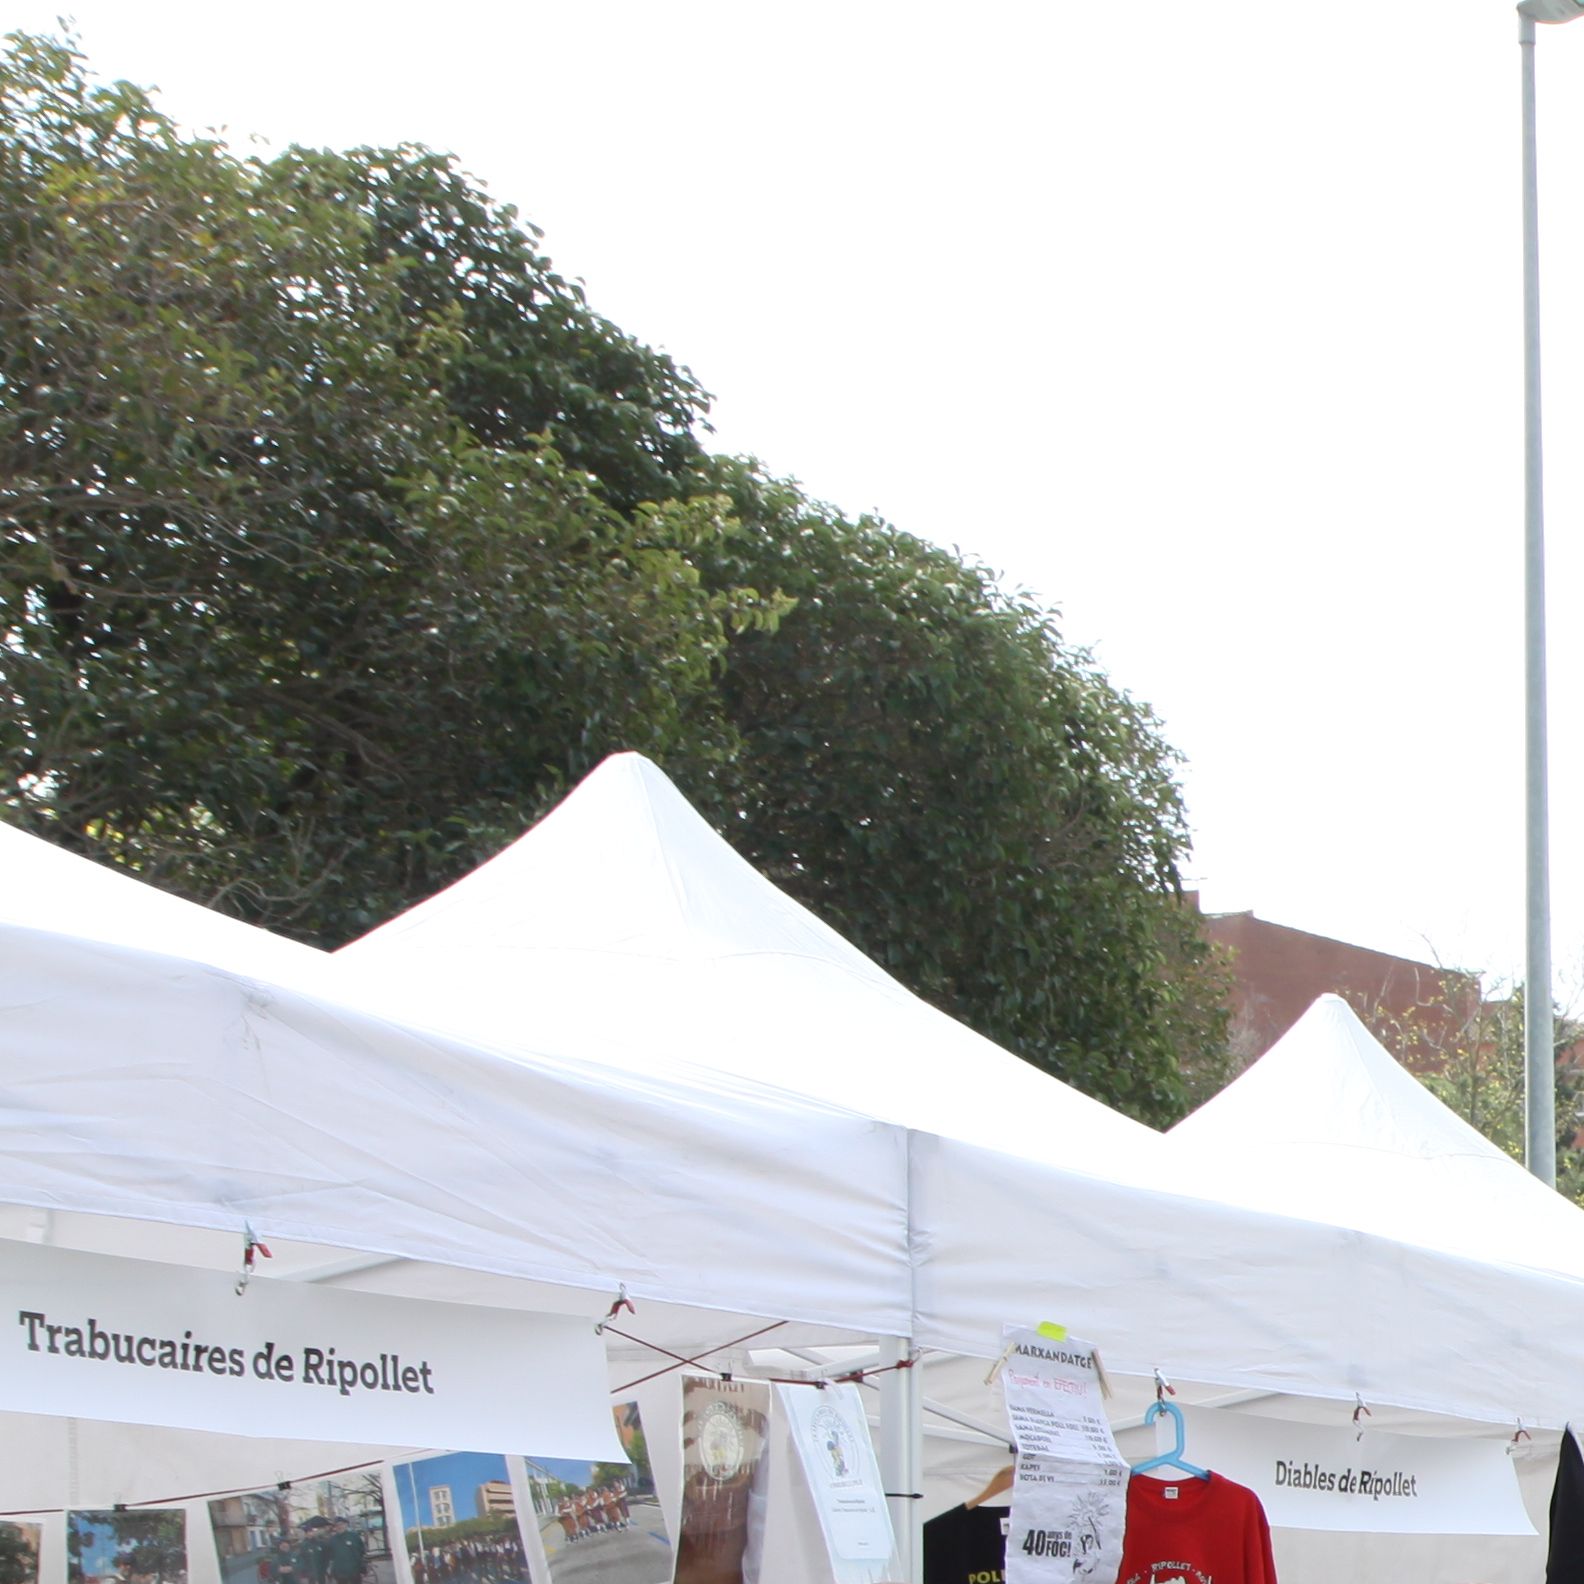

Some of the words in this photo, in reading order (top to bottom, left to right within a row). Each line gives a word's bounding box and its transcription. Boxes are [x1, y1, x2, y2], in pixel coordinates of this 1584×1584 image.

[19, 1310, 245, 1377] Trabucaires
[252, 1342, 295, 1382] de
[302, 1347, 435, 1396] Ripollet
[1275, 1460, 1336, 1491] Diables
[1338, 1468, 1357, 1493] de
[1358, 1470, 1417, 1500] Ripollet
[1022, 1529, 1046, 1556] 40
[1046, 1541, 1071, 1557] FOC!
[1151, 1561, 1191, 1571] RIPOLLET
